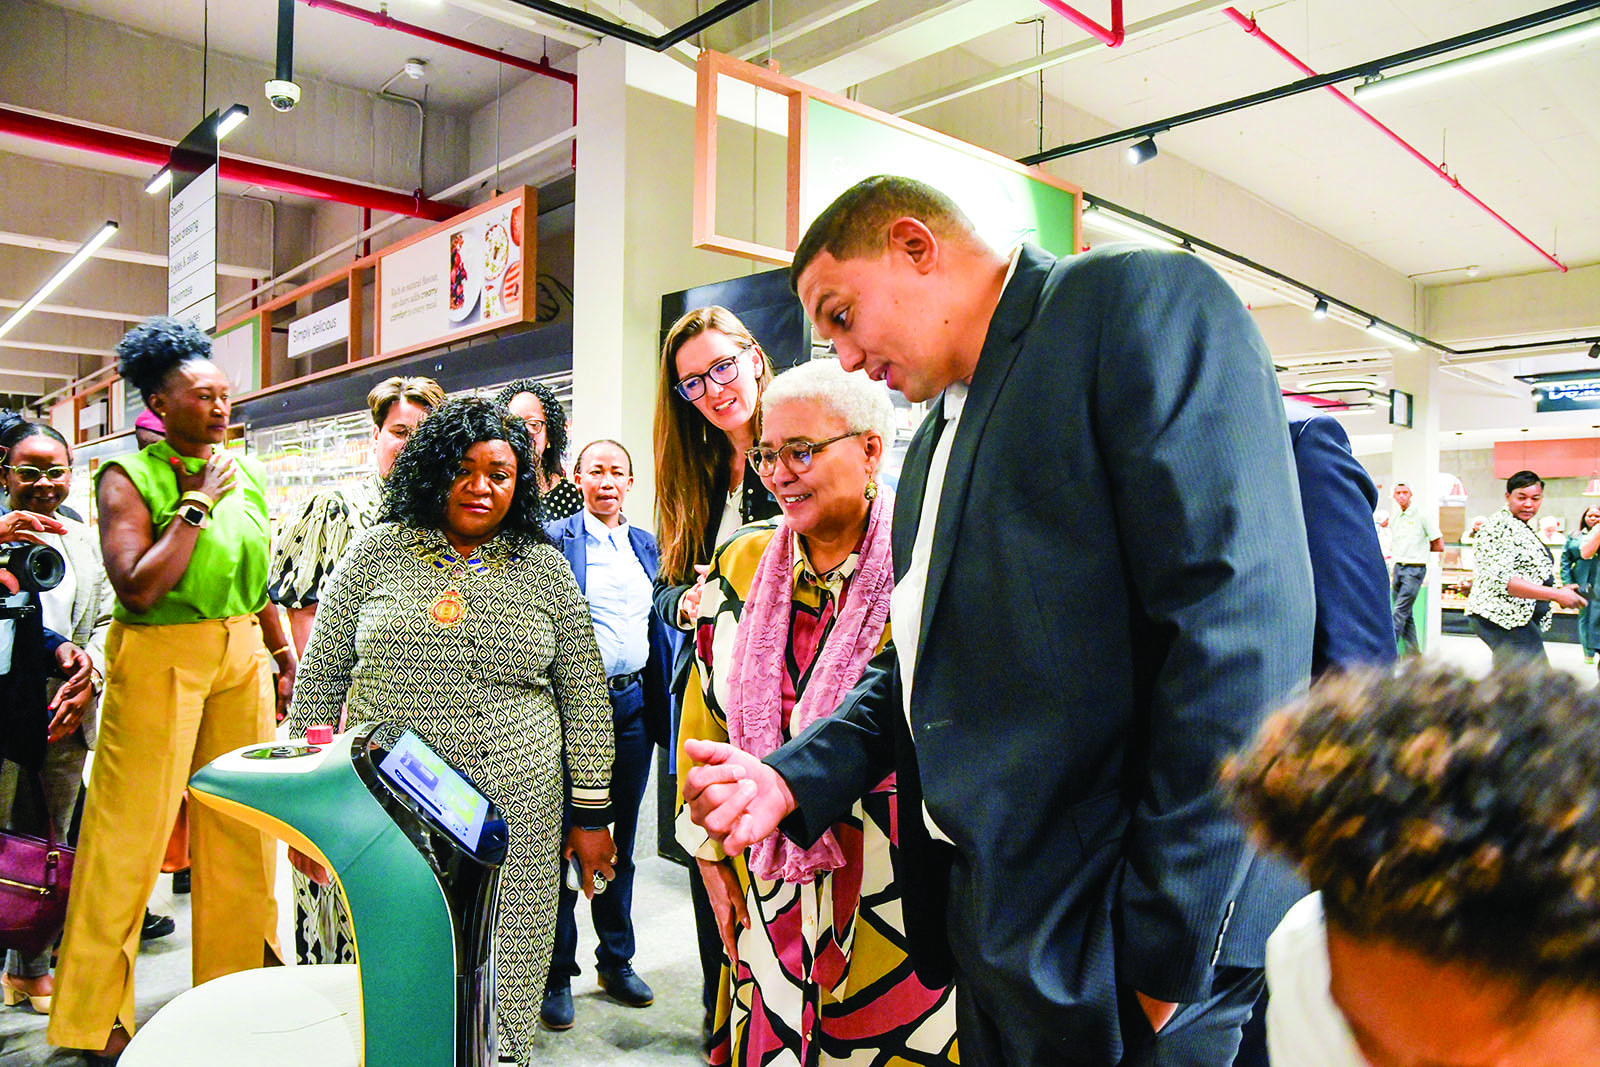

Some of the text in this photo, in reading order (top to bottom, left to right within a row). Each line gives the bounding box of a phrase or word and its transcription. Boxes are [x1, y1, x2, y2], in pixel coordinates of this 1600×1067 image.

[181, 219, 199, 239] dressing
[293, 317, 336, 343] Simply delicious
